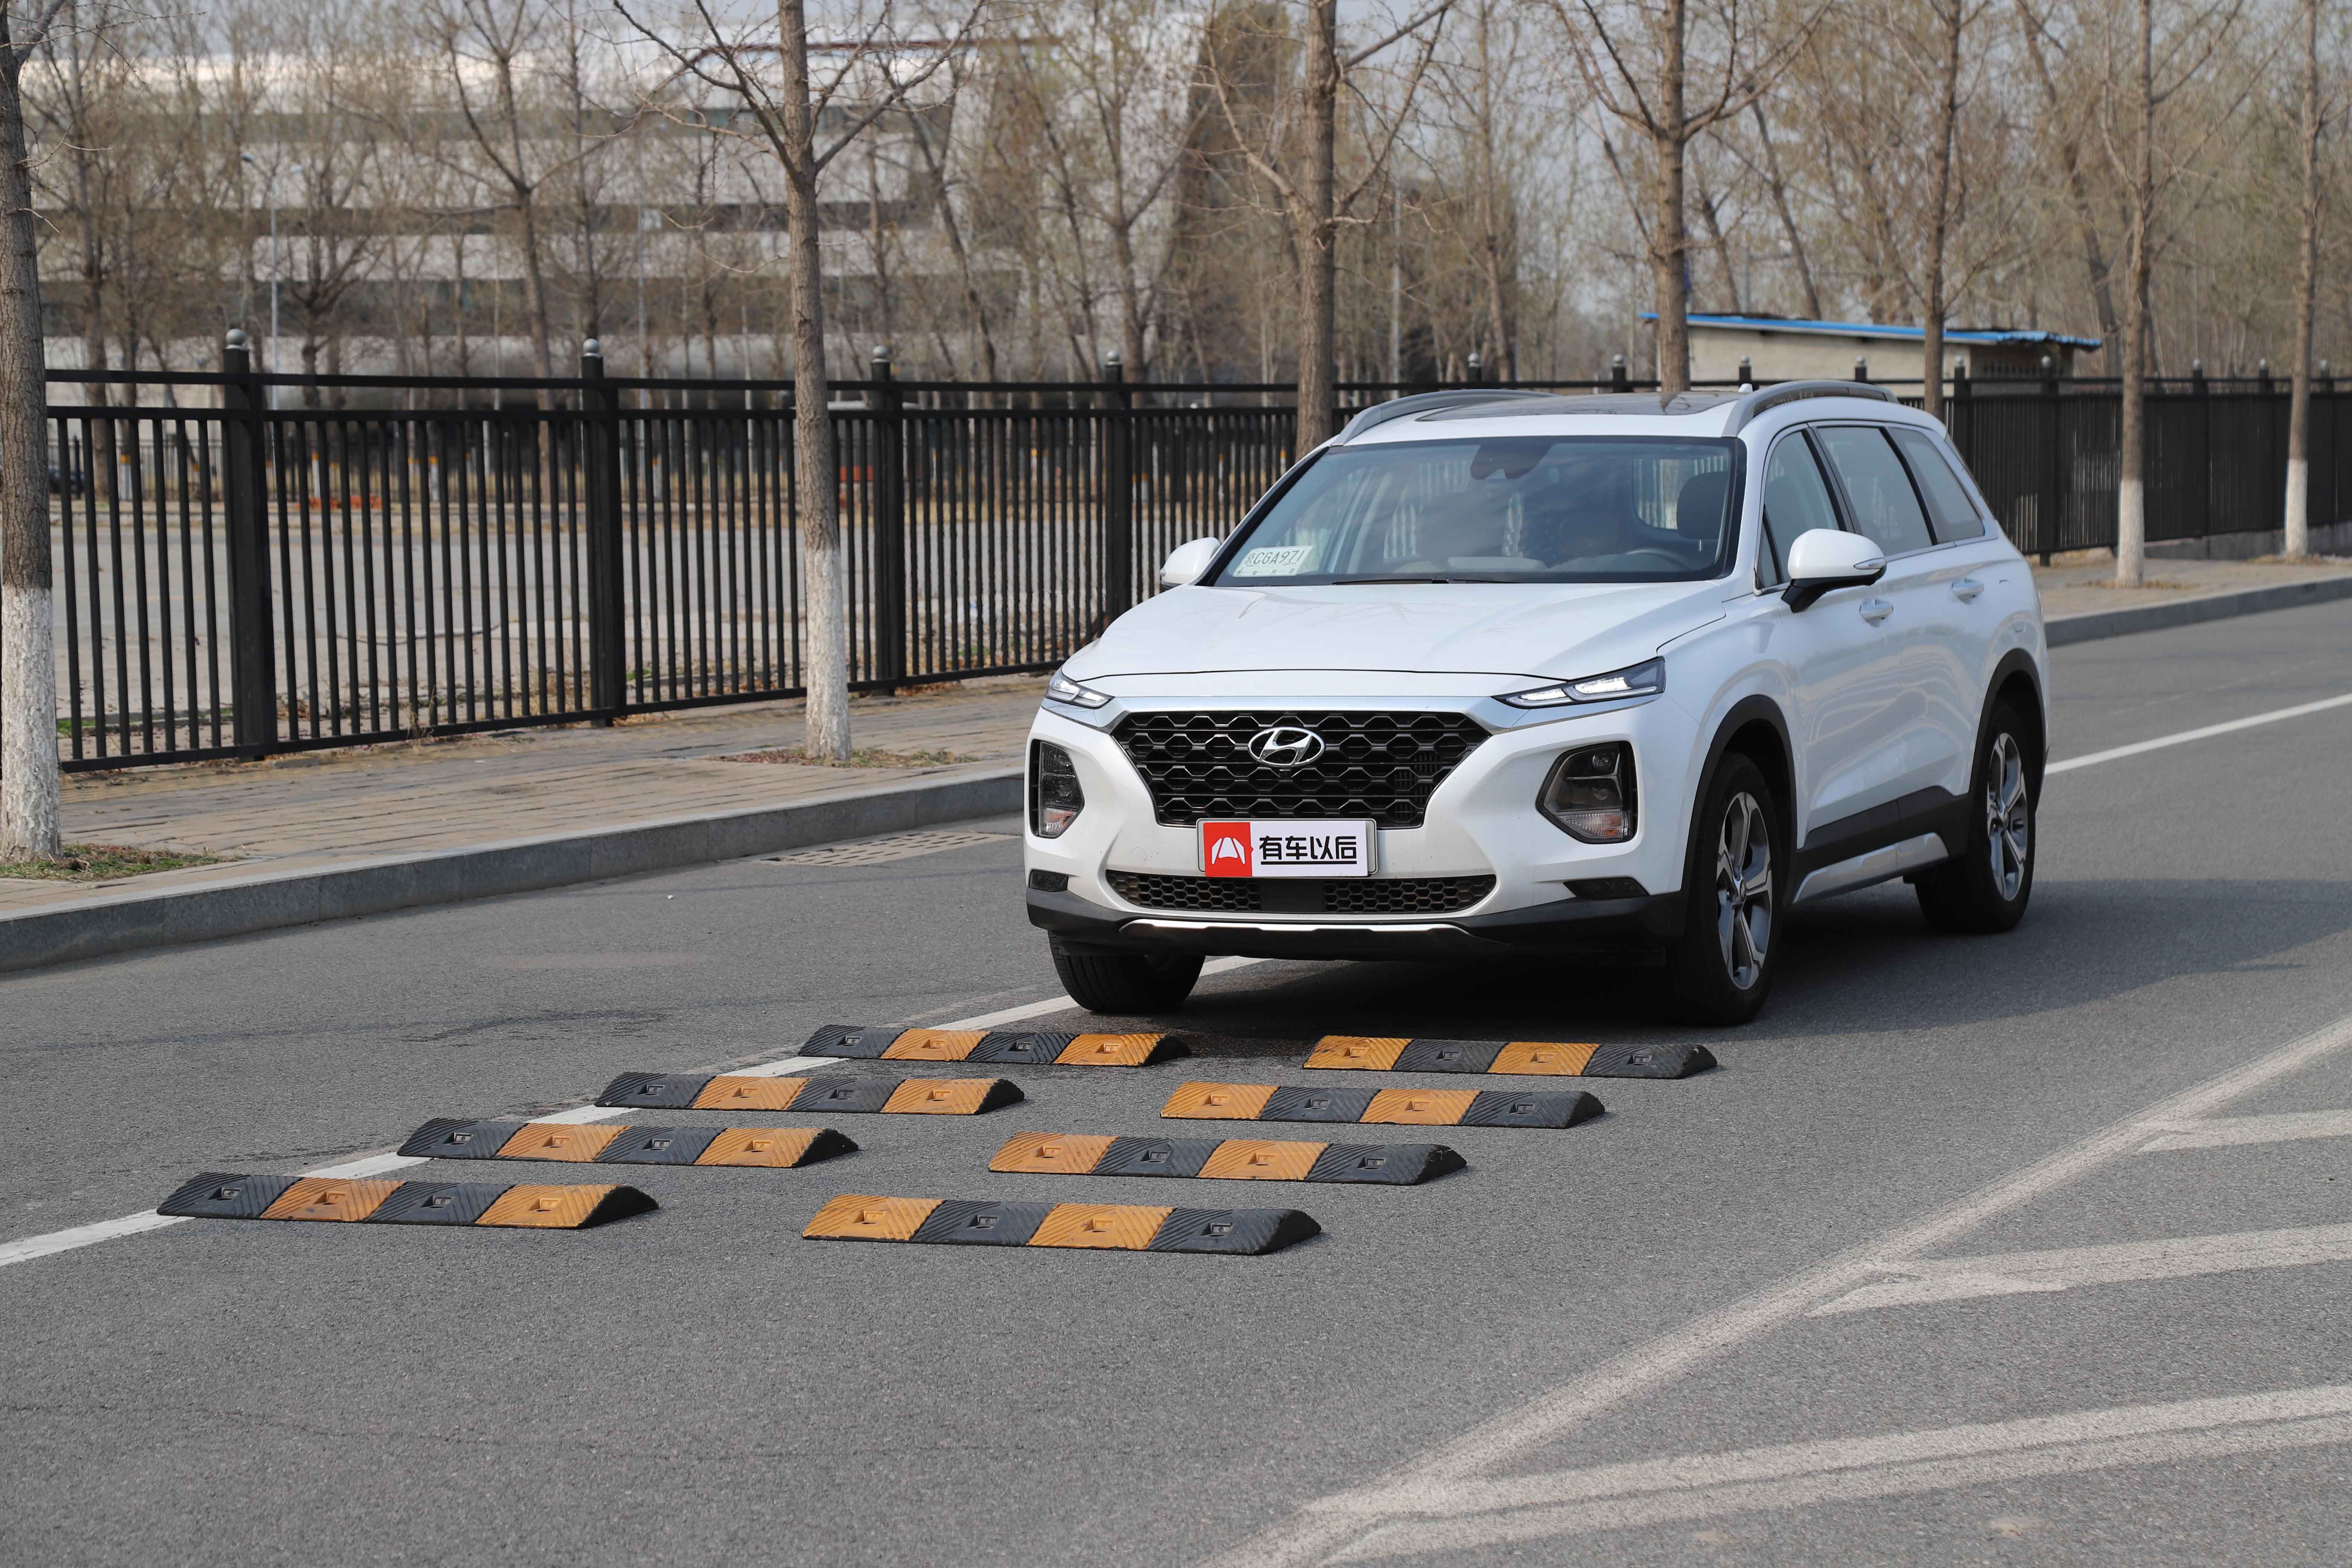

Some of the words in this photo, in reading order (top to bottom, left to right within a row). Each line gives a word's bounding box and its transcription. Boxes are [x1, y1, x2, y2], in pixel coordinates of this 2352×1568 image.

[1244, 550, 1305, 564] 京CGA971
[1259, 836, 1357, 860] 有车以后
